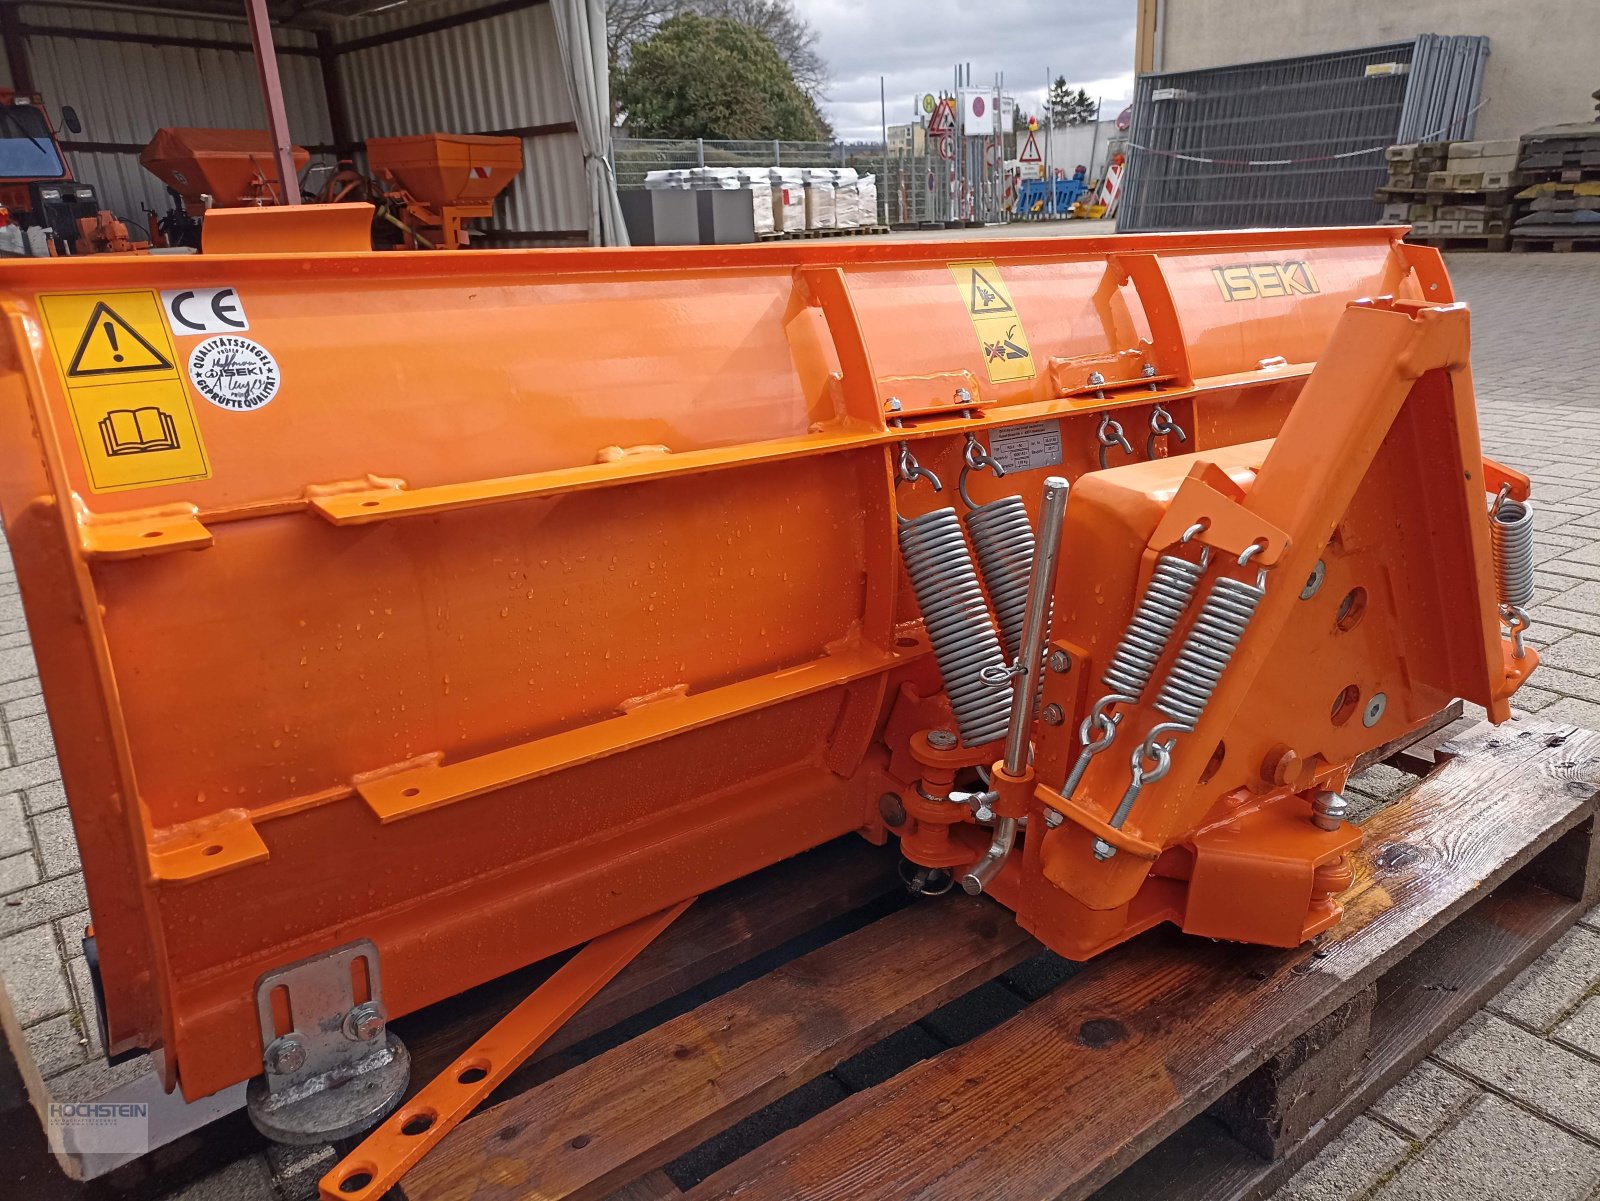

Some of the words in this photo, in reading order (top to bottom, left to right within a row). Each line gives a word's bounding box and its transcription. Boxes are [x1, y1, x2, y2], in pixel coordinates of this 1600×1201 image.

[1210, 259, 1321, 302] ISEKI
[171, 288, 246, 331] CE
[193, 337, 272, 369] QUALITÄTSSIEGEL
[220, 366, 264, 378] ISEKI
